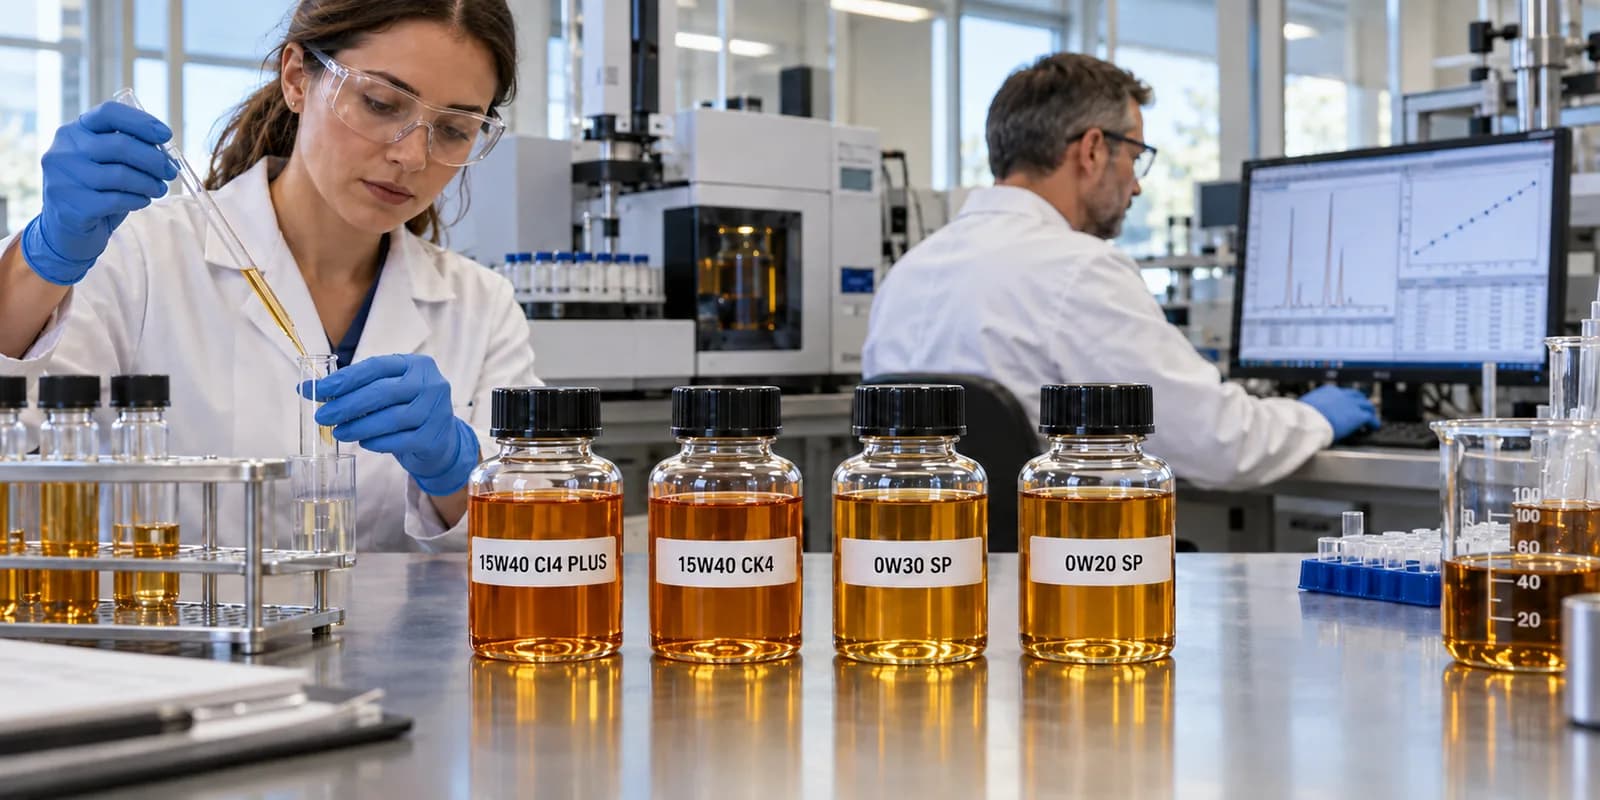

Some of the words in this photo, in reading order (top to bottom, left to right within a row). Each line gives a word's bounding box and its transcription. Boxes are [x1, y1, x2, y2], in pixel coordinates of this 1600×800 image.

[1516, 508, 1541, 523] 100
[1517, 540, 1540, 555] 60
[479, 554, 529, 573] 15W40
[534, 556, 562, 573] CI4
[568, 553, 607, 572] PLUS
[679, 556, 736, 574] 15W40
[741, 556, 774, 573] CK4
[874, 556, 924, 574] 0W30
[930, 556, 952, 574] SP
[1065, 555, 1116, 572] 0W20
[1122, 554, 1143, 572] SP
[1517, 574, 1541, 590] 40
[1517, 612, 1541, 628] 20
